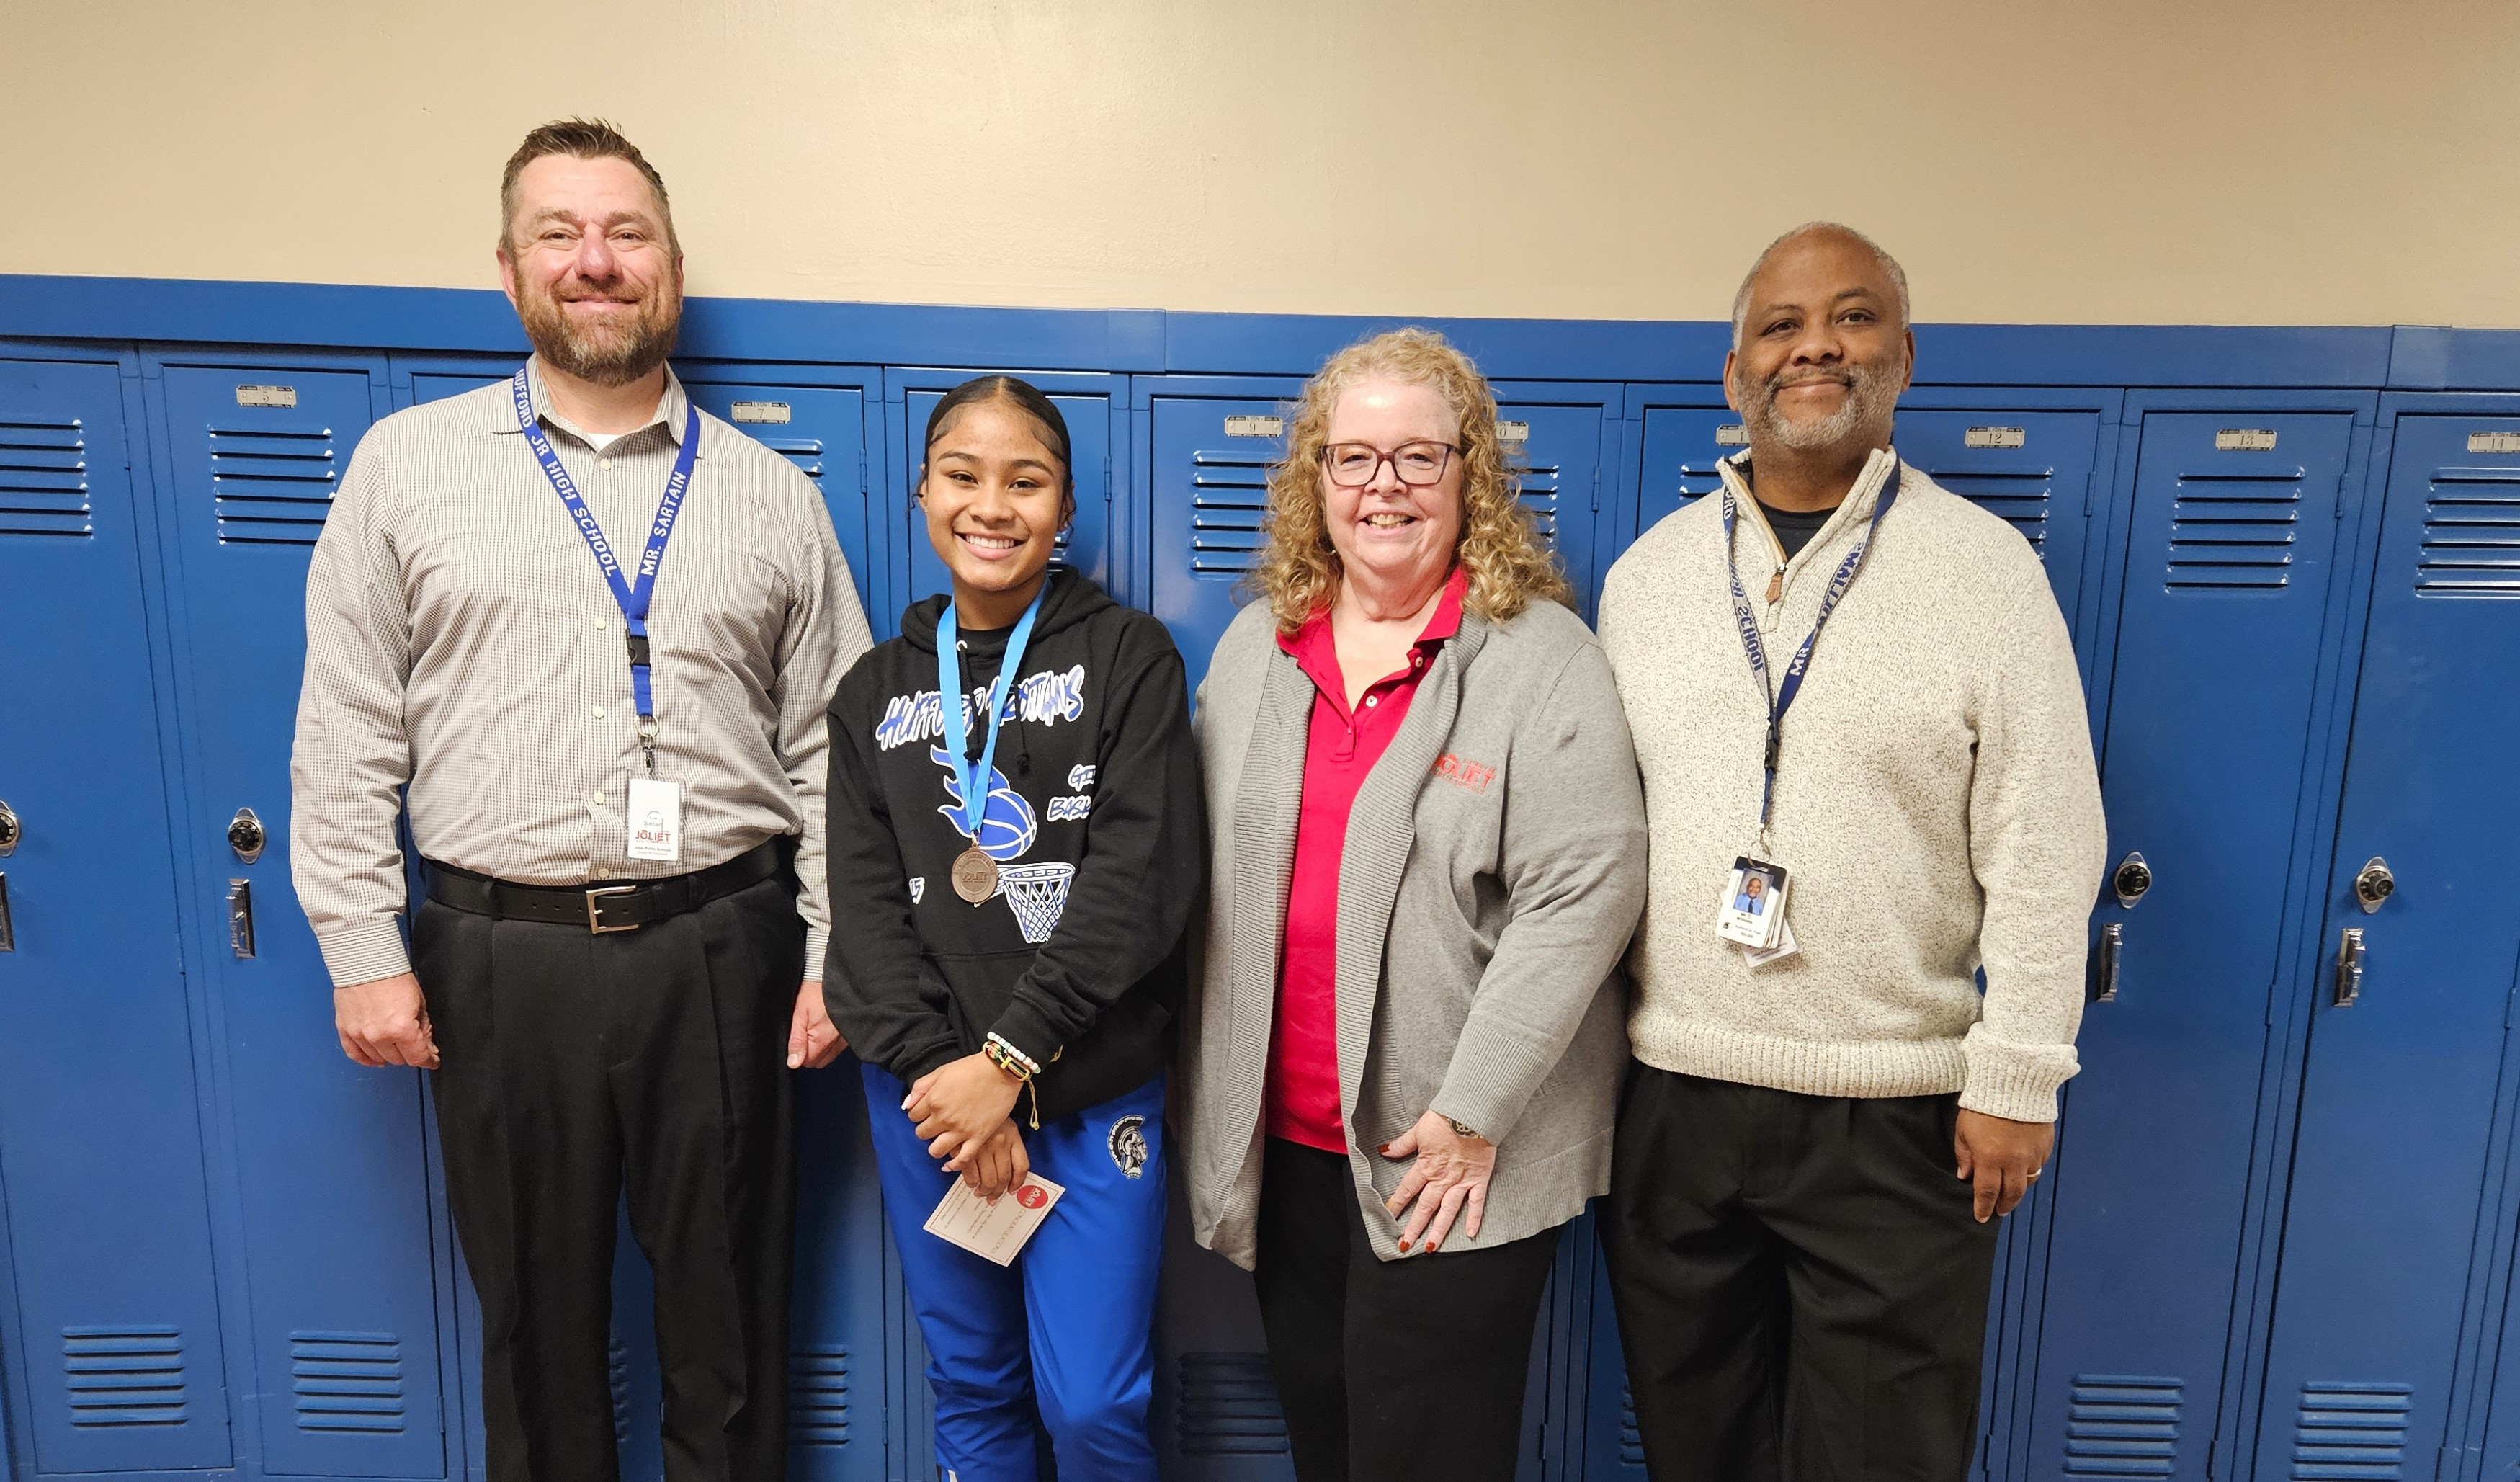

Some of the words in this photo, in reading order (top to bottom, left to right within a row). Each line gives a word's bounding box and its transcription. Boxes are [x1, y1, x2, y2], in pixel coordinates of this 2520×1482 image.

[262, 390, 269, 402] 5
[757, 408, 764, 419] 7
[1249, 421, 1256, 432] 9
[1988, 433, 2002, 444] 12
[2240, 434, 2253, 446] 13
[514, 367, 534, 429] HUFFORD
[530, 434, 550, 458] JR
[546, 460, 577, 501] HIGH
[573, 506, 619, 578] SCHOOL
[640, 545, 663, 577] MR.
[653, 470, 687, 539] SARTAIN
[635, 829, 671, 842] JOLIET
[962, 872, 988, 880] JOLIET
[1024, 1187, 1042, 1208] JOLIET
[990, 1208, 1027, 1254] CONGRATULATIONS
